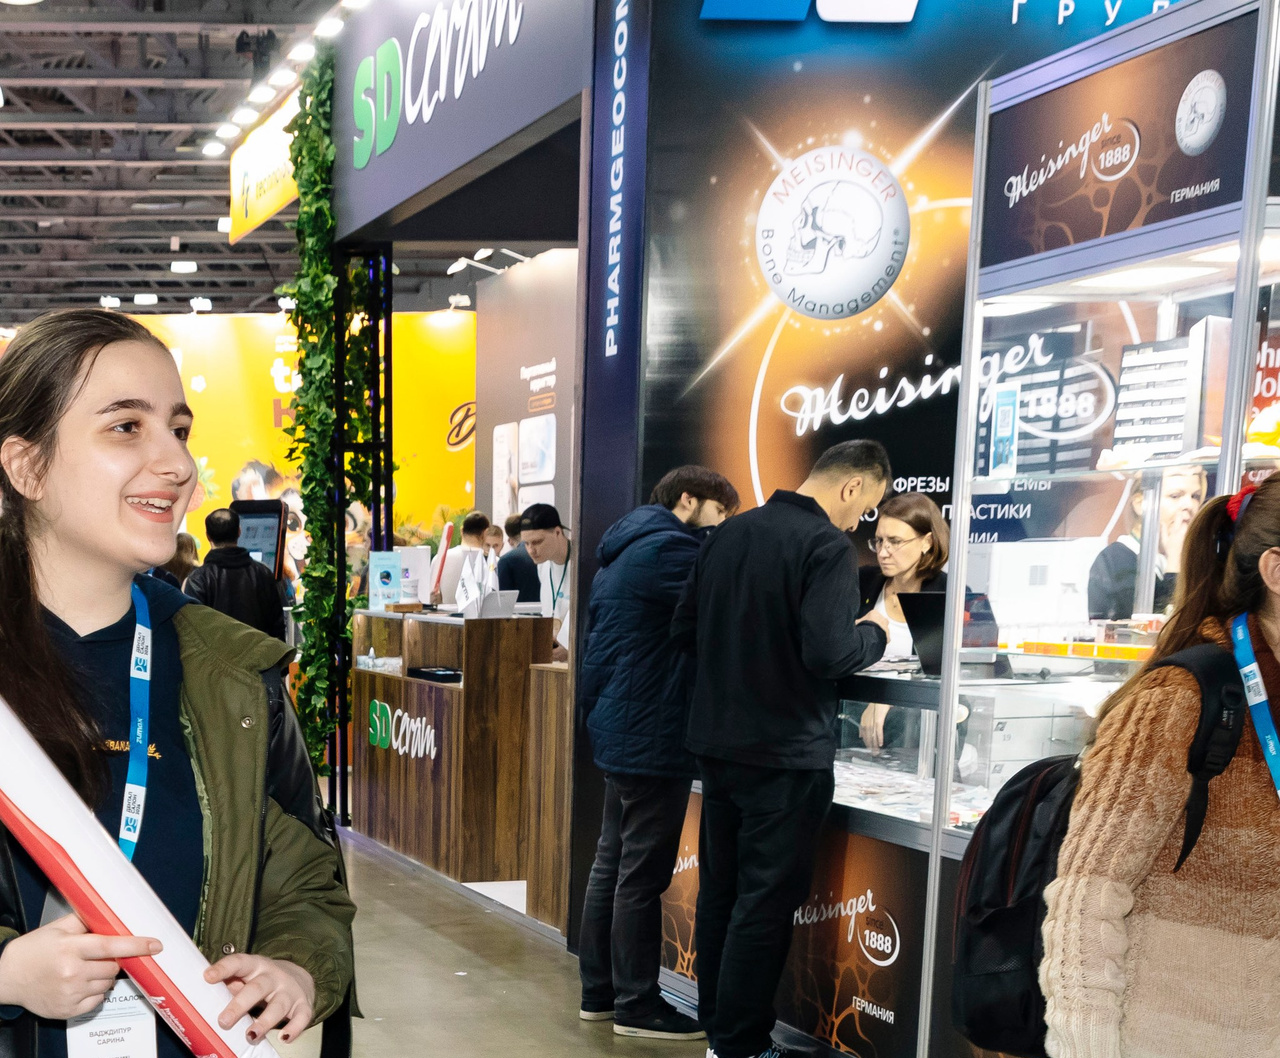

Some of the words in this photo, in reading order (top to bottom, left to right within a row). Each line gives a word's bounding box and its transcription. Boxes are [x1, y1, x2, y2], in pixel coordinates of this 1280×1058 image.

[1004, 112, 1112, 208] Meisinger
[1099, 144, 1131, 170] 1888
[772, 151, 897, 205] MEISINGER
[1170, 178, 1220, 204] ГЕРМАНИЯ
[761, 228, 783, 286] Bone
[1026, 391, 1096, 419] 1888
[893, 476, 950, 493] ФРЕЗЫ
[864, 929, 892, 954] 1888
[852, 996, 895, 1025] ГЕРМАНИЯ
[96, 1036, 125, 1046] САРИНА
